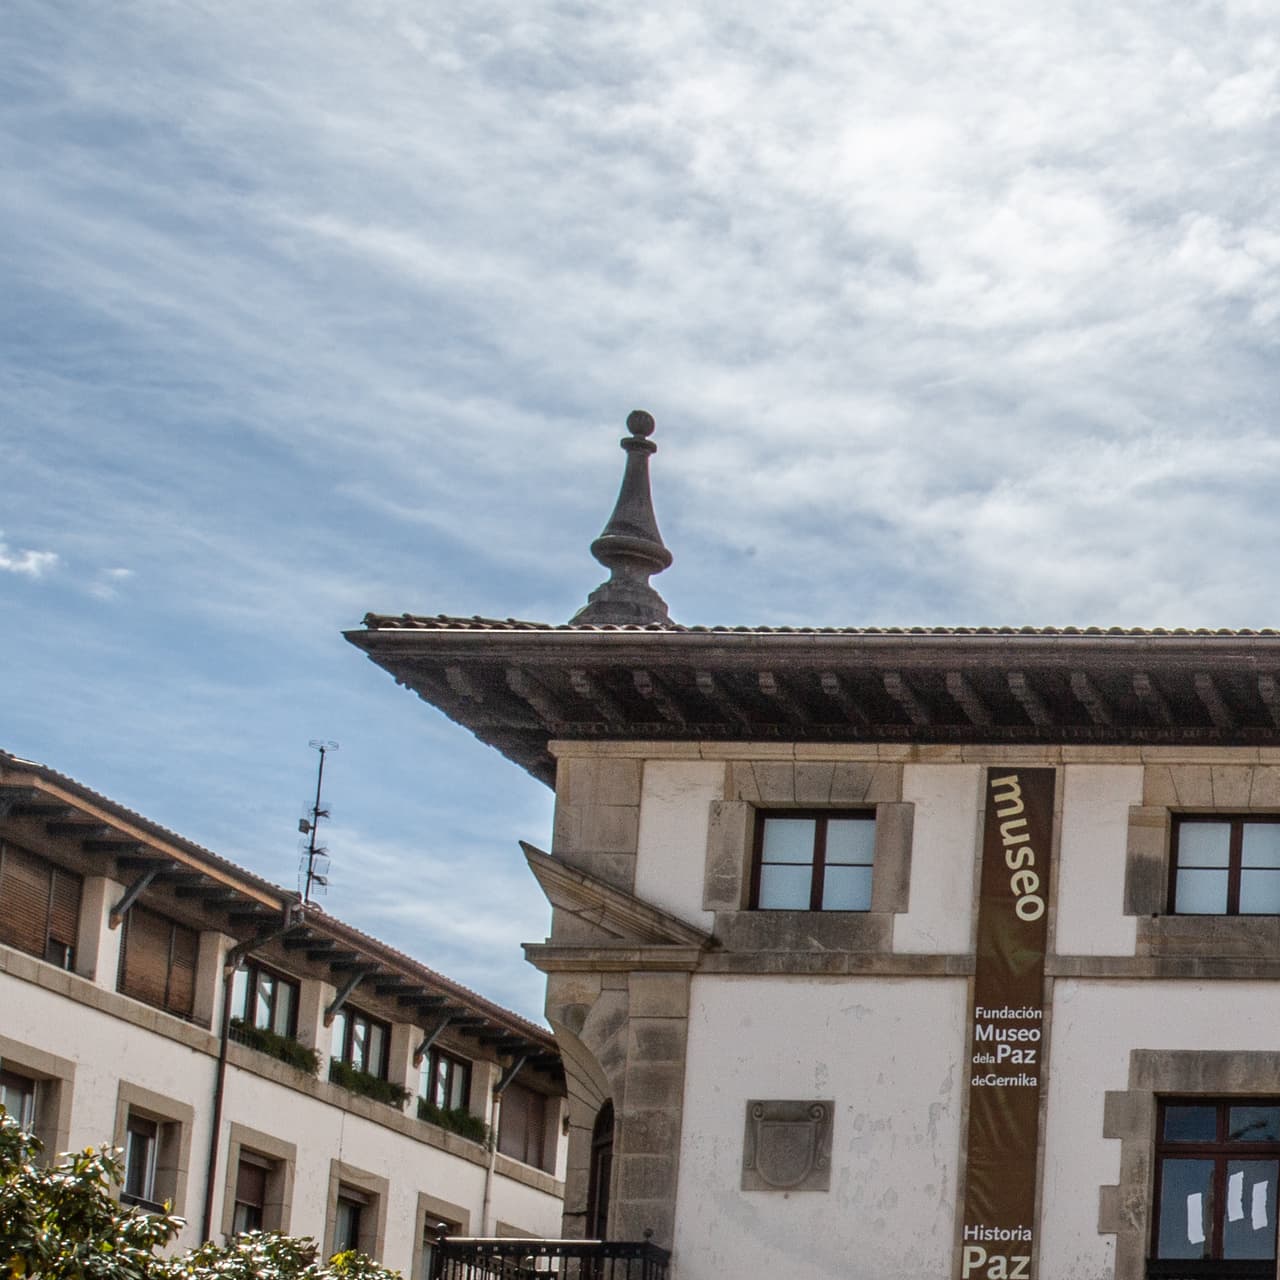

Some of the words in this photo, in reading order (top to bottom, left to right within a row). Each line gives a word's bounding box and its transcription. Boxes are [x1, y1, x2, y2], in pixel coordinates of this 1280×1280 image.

[991, 774, 1045, 921] museo
[975, 1005, 1042, 1019] Fundación
[975, 1023, 1041, 1041] Museo
[997, 1044, 1036, 1064] Paz
[964, 1224, 1032, 1241] Historia
[962, 1246, 1030, 1280] Paz
